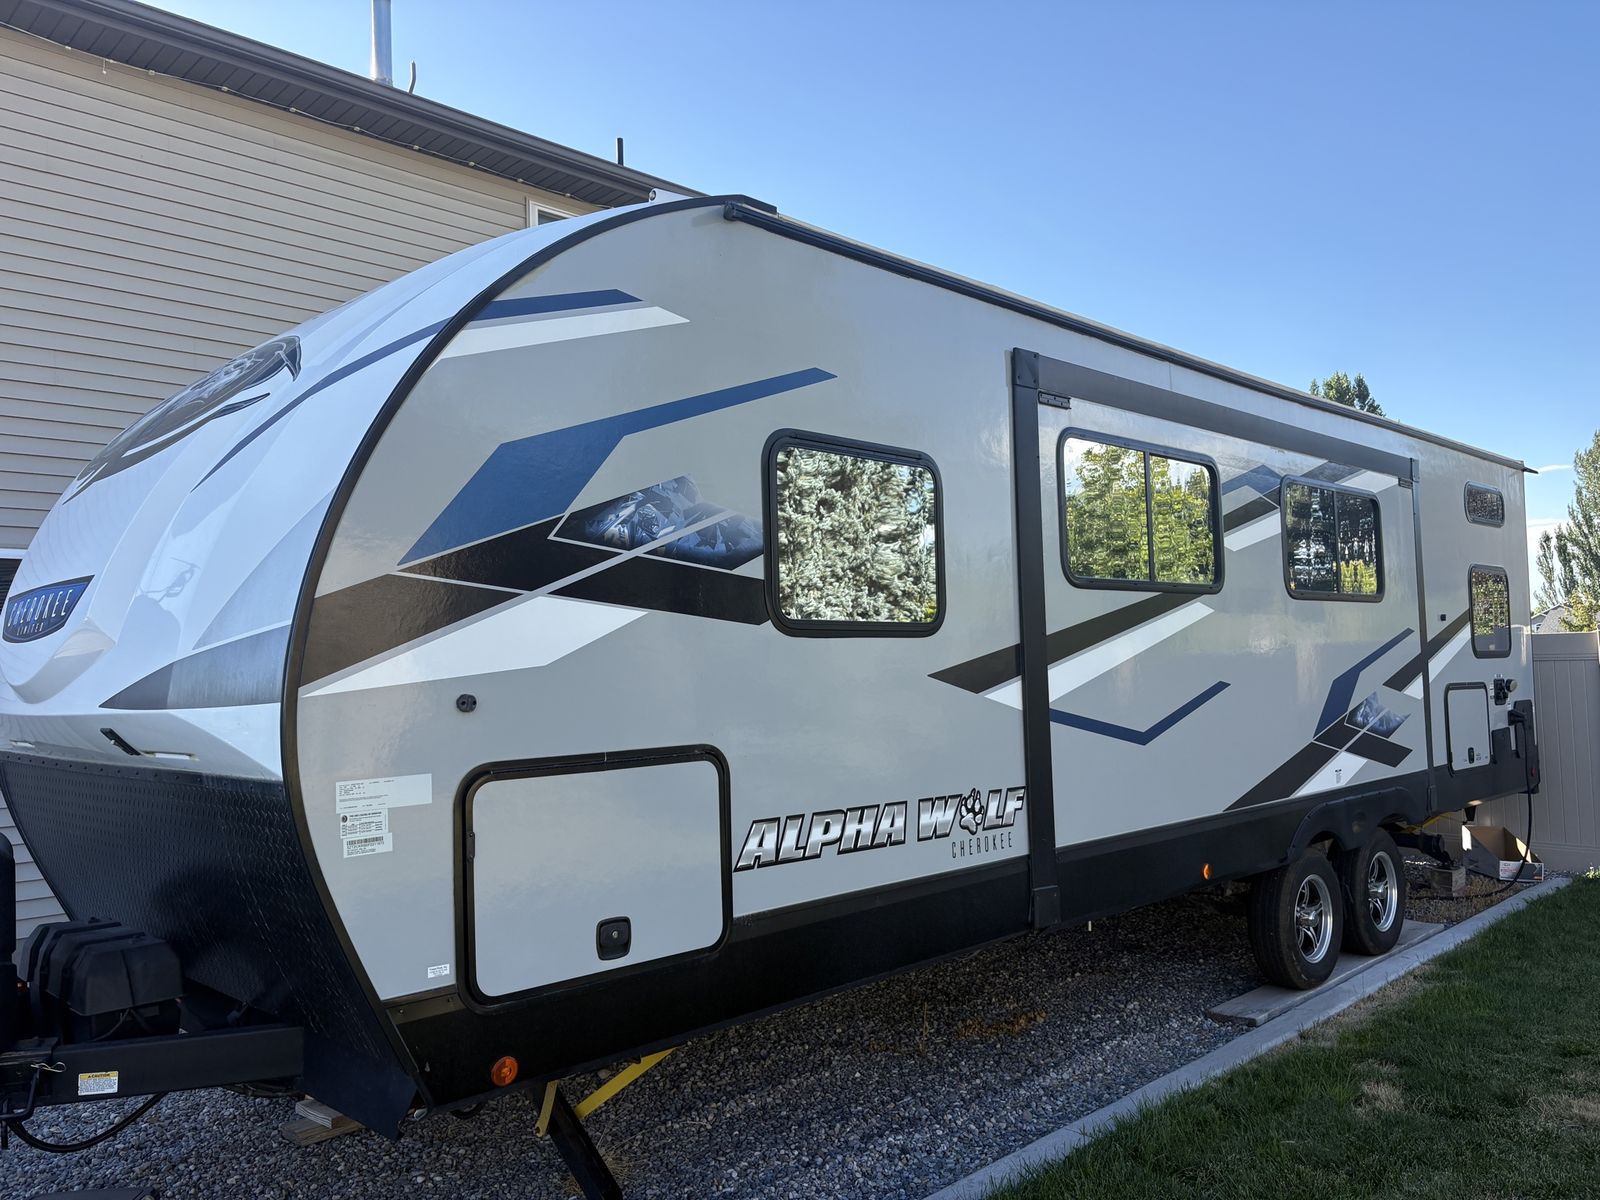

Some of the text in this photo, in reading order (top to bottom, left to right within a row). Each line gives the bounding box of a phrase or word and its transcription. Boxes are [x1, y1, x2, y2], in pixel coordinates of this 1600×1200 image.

[8, 589, 73, 627] CHEROKEE
[733, 801, 907, 872] ALPHA
[951, 831, 1013, 859] CHEROKEE
